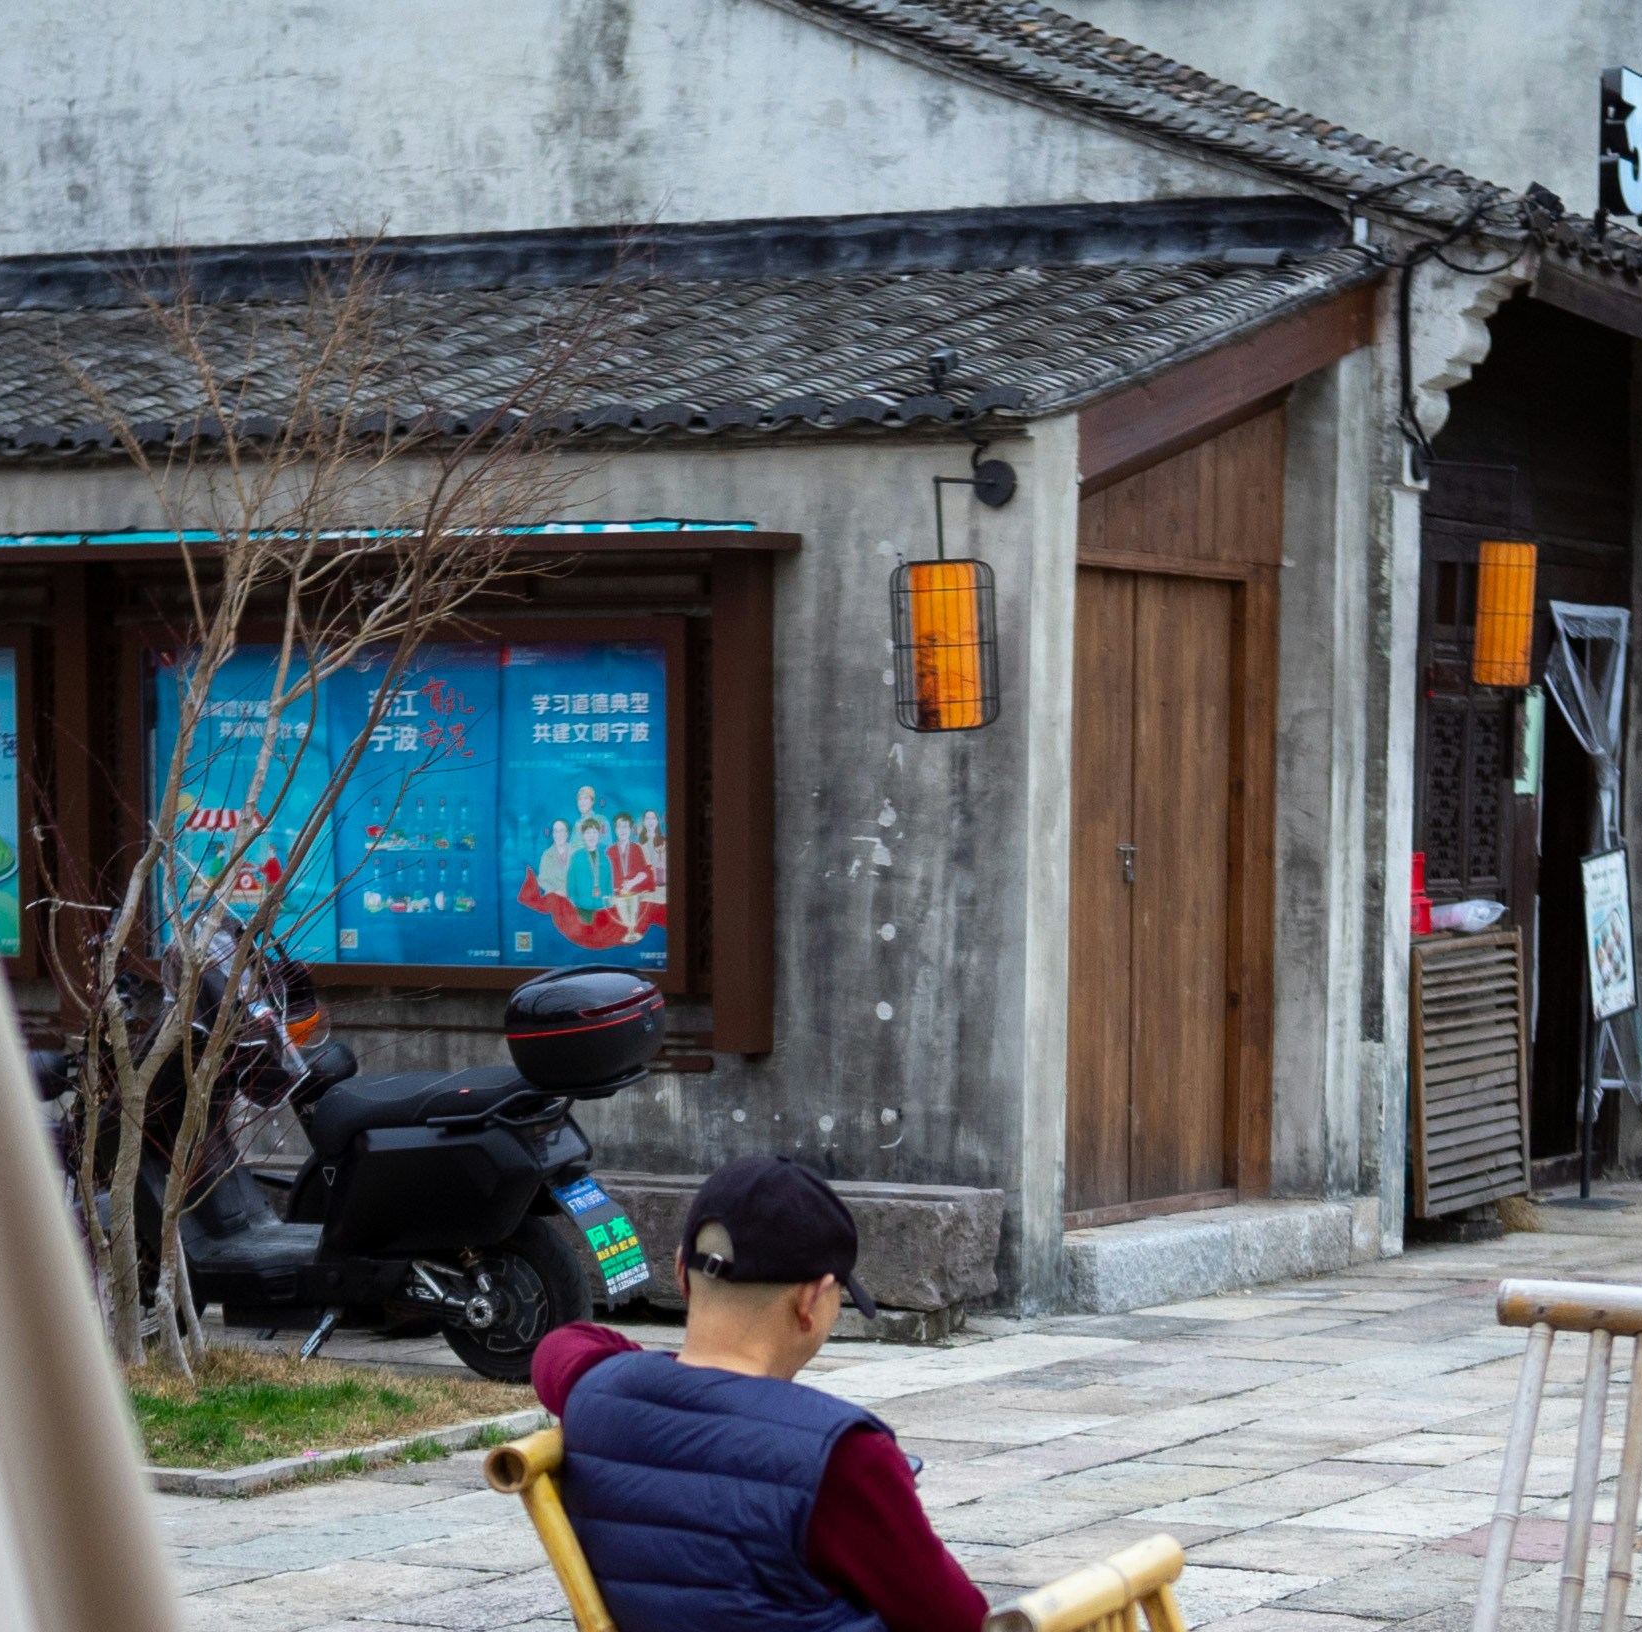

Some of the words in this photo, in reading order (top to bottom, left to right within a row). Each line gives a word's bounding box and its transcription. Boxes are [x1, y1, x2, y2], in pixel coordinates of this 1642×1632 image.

[531, 692, 650, 716] 学习道德典型
[531, 721, 650, 745] 共建文明宁波
[585, 1216, 634, 1251] 阿亮
